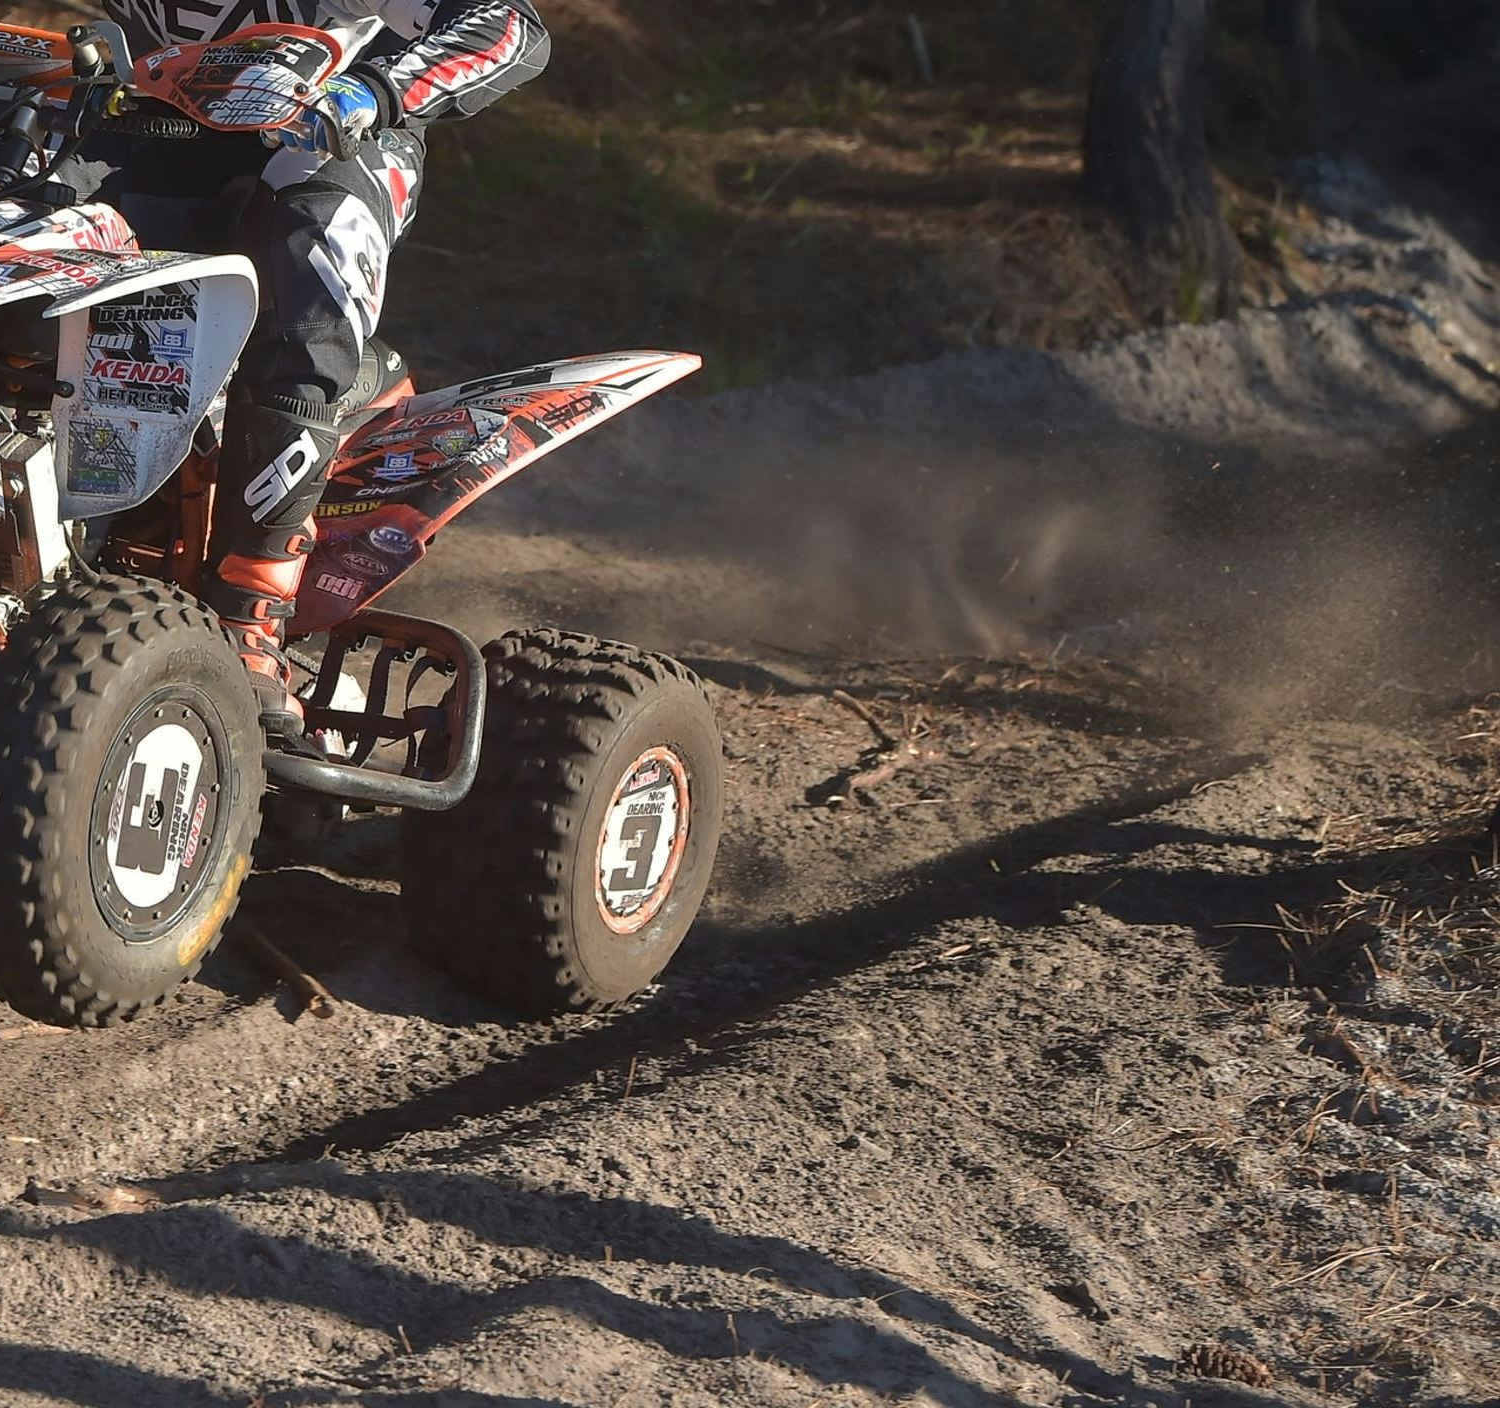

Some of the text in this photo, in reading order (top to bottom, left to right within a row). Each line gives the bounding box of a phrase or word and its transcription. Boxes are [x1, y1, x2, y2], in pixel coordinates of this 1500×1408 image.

[199, 53, 276, 66] DEARING
[203, 43, 245, 55] NICK
[11, 254, 99, 288] KENDA
[145, 293, 196, 308] NICK
[100, 306, 185, 322] DEARING
[89, 358, 187, 385] KENDA
[647, 791, 667, 802] NICK
[166, 761, 190, 862] DEARING
[626, 802, 666, 816] DEARING
[174, 811, 190, 860] NICK
[181, 793, 208, 869] KENDA
[609, 814, 663, 892] 3
